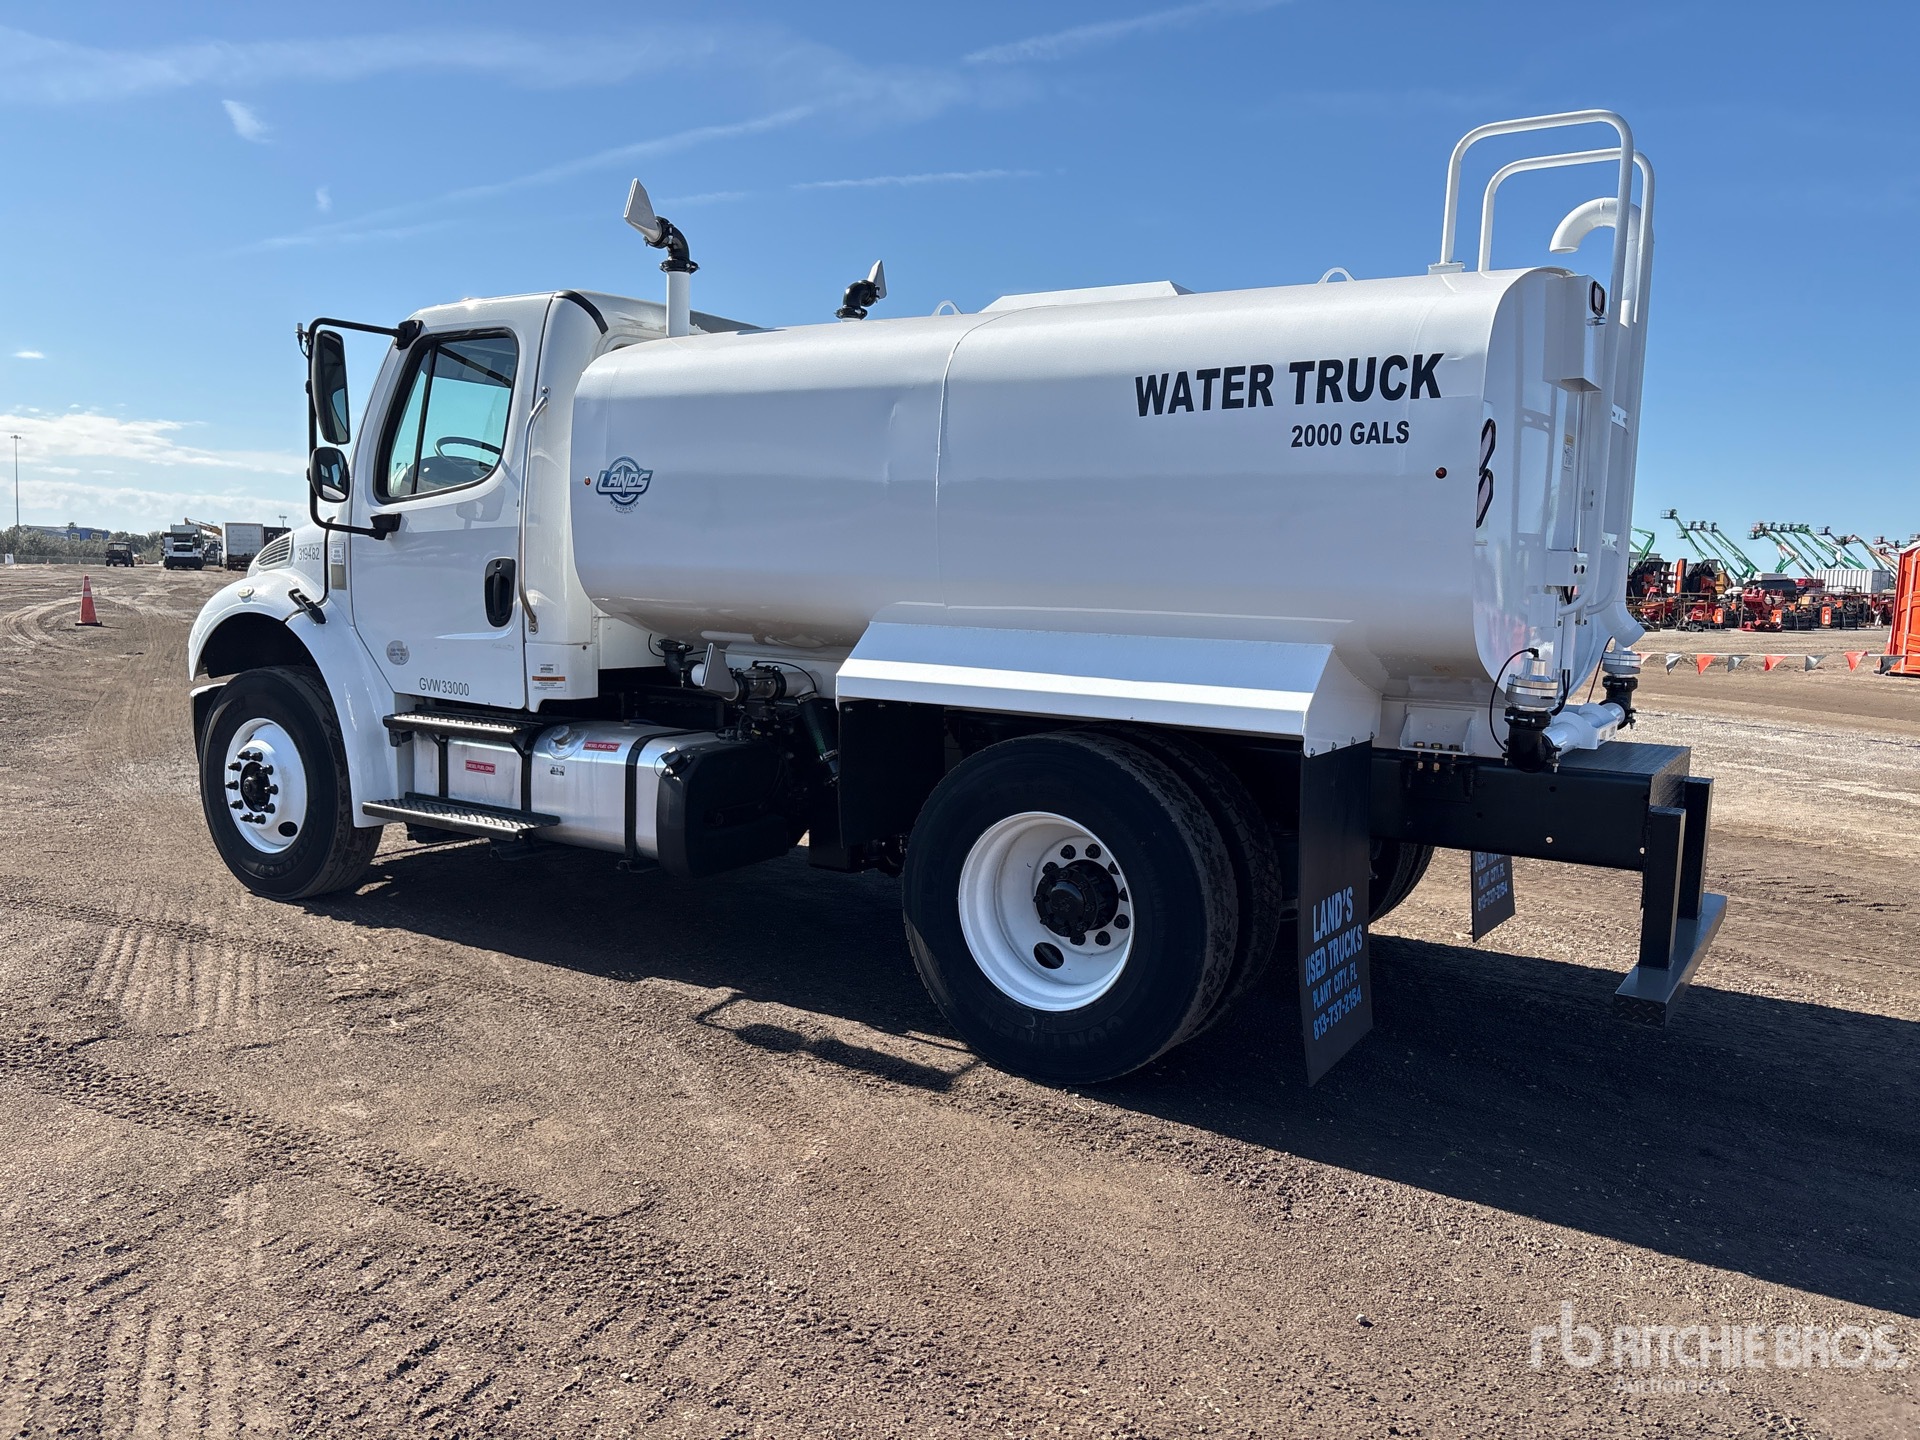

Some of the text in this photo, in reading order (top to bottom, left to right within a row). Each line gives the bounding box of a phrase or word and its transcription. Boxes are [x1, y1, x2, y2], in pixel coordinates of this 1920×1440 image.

[1135, 352, 1445, 417] WATER TRUCK
[1291, 420, 1410, 448] 2000 GALS
[298, 547, 320, 560] 319482
[419, 677, 469, 697] GVW33000
[1313, 886, 1354, 943] LAND'S
[1305, 923, 1363, 987] USED TRUCKS
[1312, 962, 1358, 1011] PLANT CITY, FL
[1313, 984, 1362, 1041] 813-737-2154
